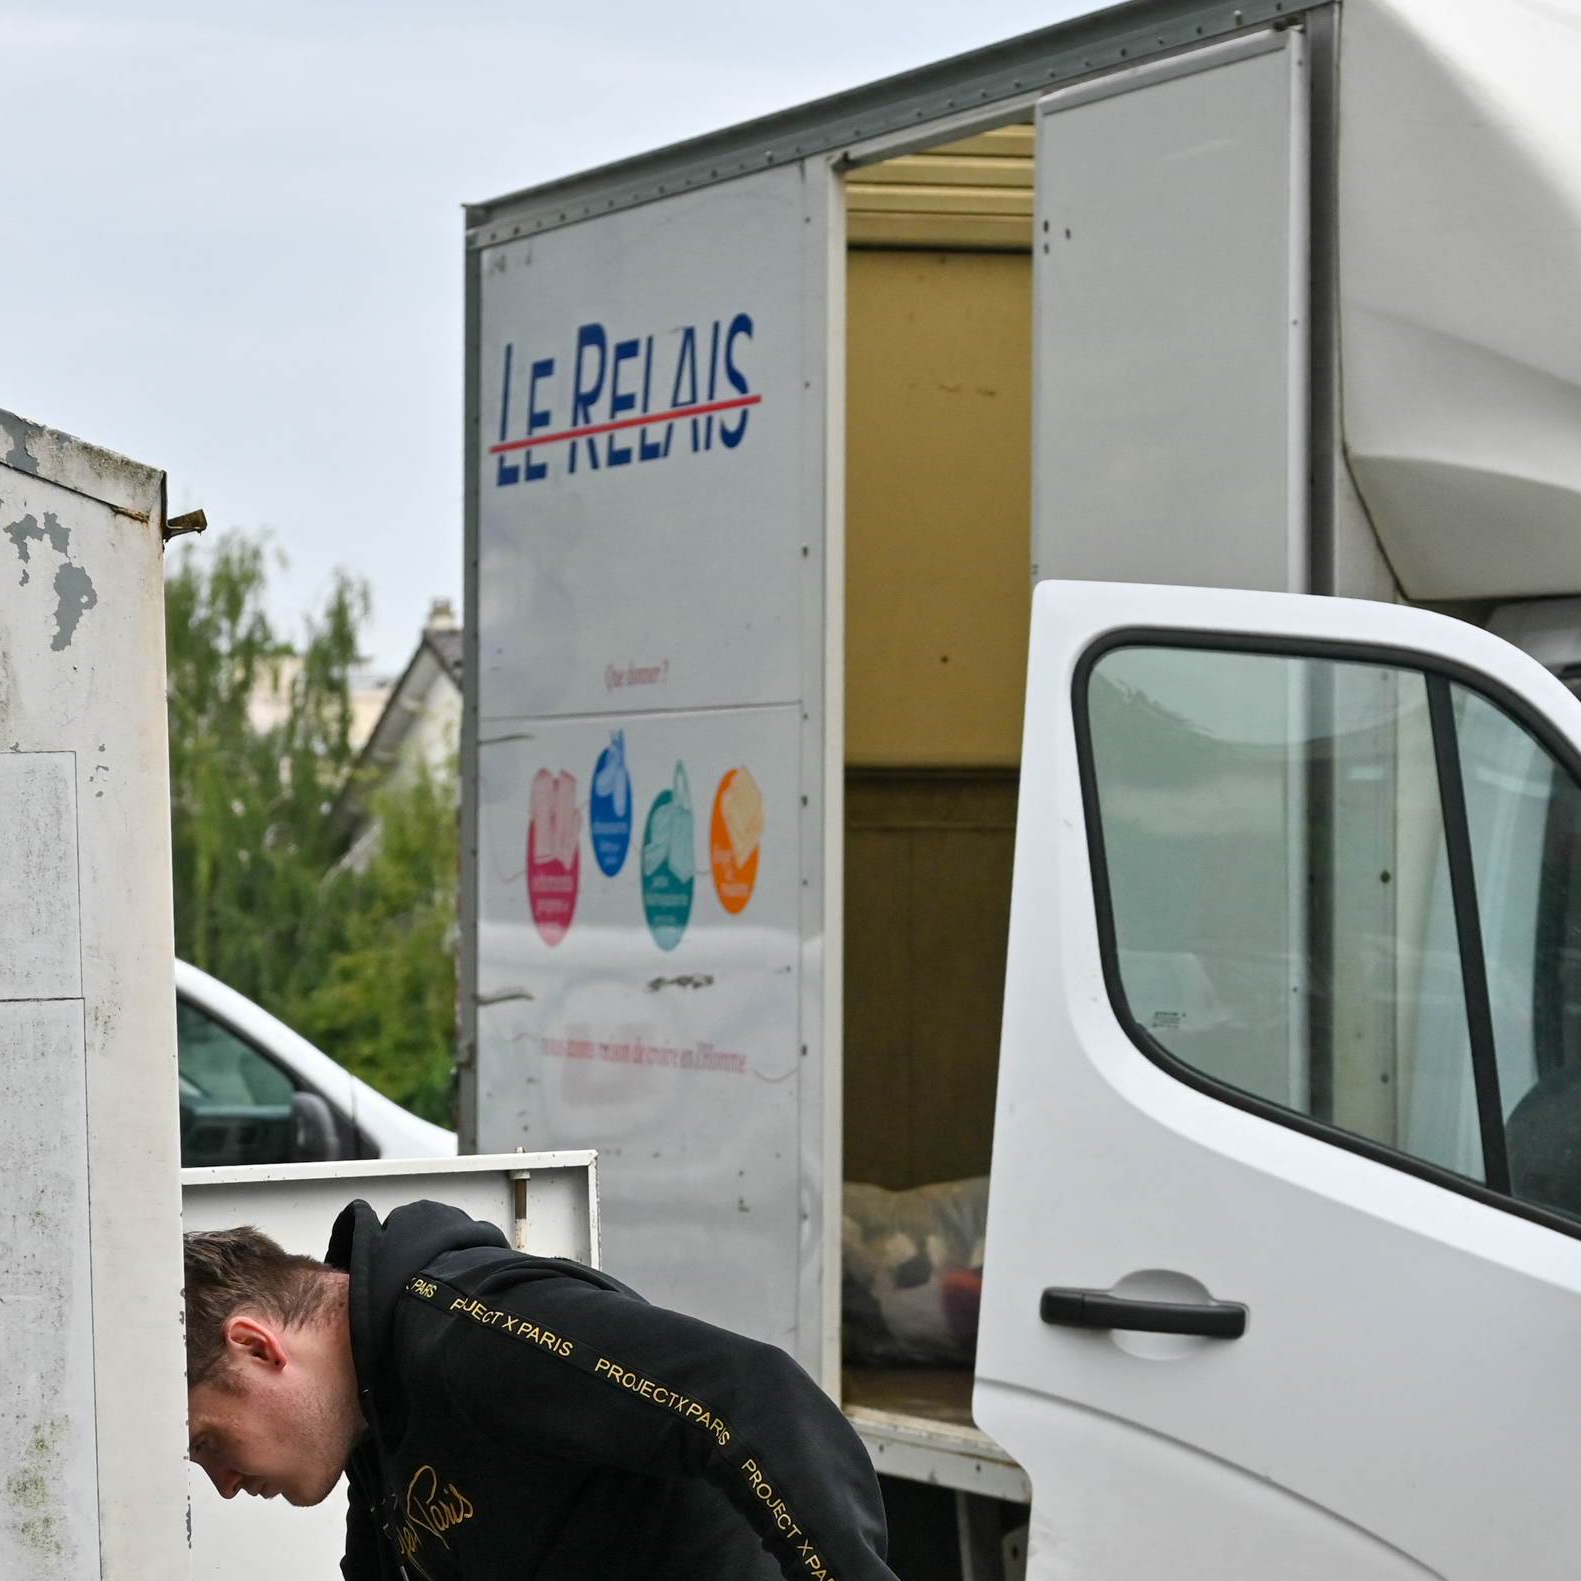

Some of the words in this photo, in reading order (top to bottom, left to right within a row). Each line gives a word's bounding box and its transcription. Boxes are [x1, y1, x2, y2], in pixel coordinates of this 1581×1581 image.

[497, 343, 555, 487] LE
[568, 312, 754, 475] RELAIS
[501, 1315, 520, 1332] X
[516, 1322, 574, 1357] PARIS
[594, 1357, 679, 1408] PROJECT
[685, 1402, 731, 1446] PARIS
[741, 1458, 802, 1539] PROJECT
[796, 1538, 814, 1557] X
